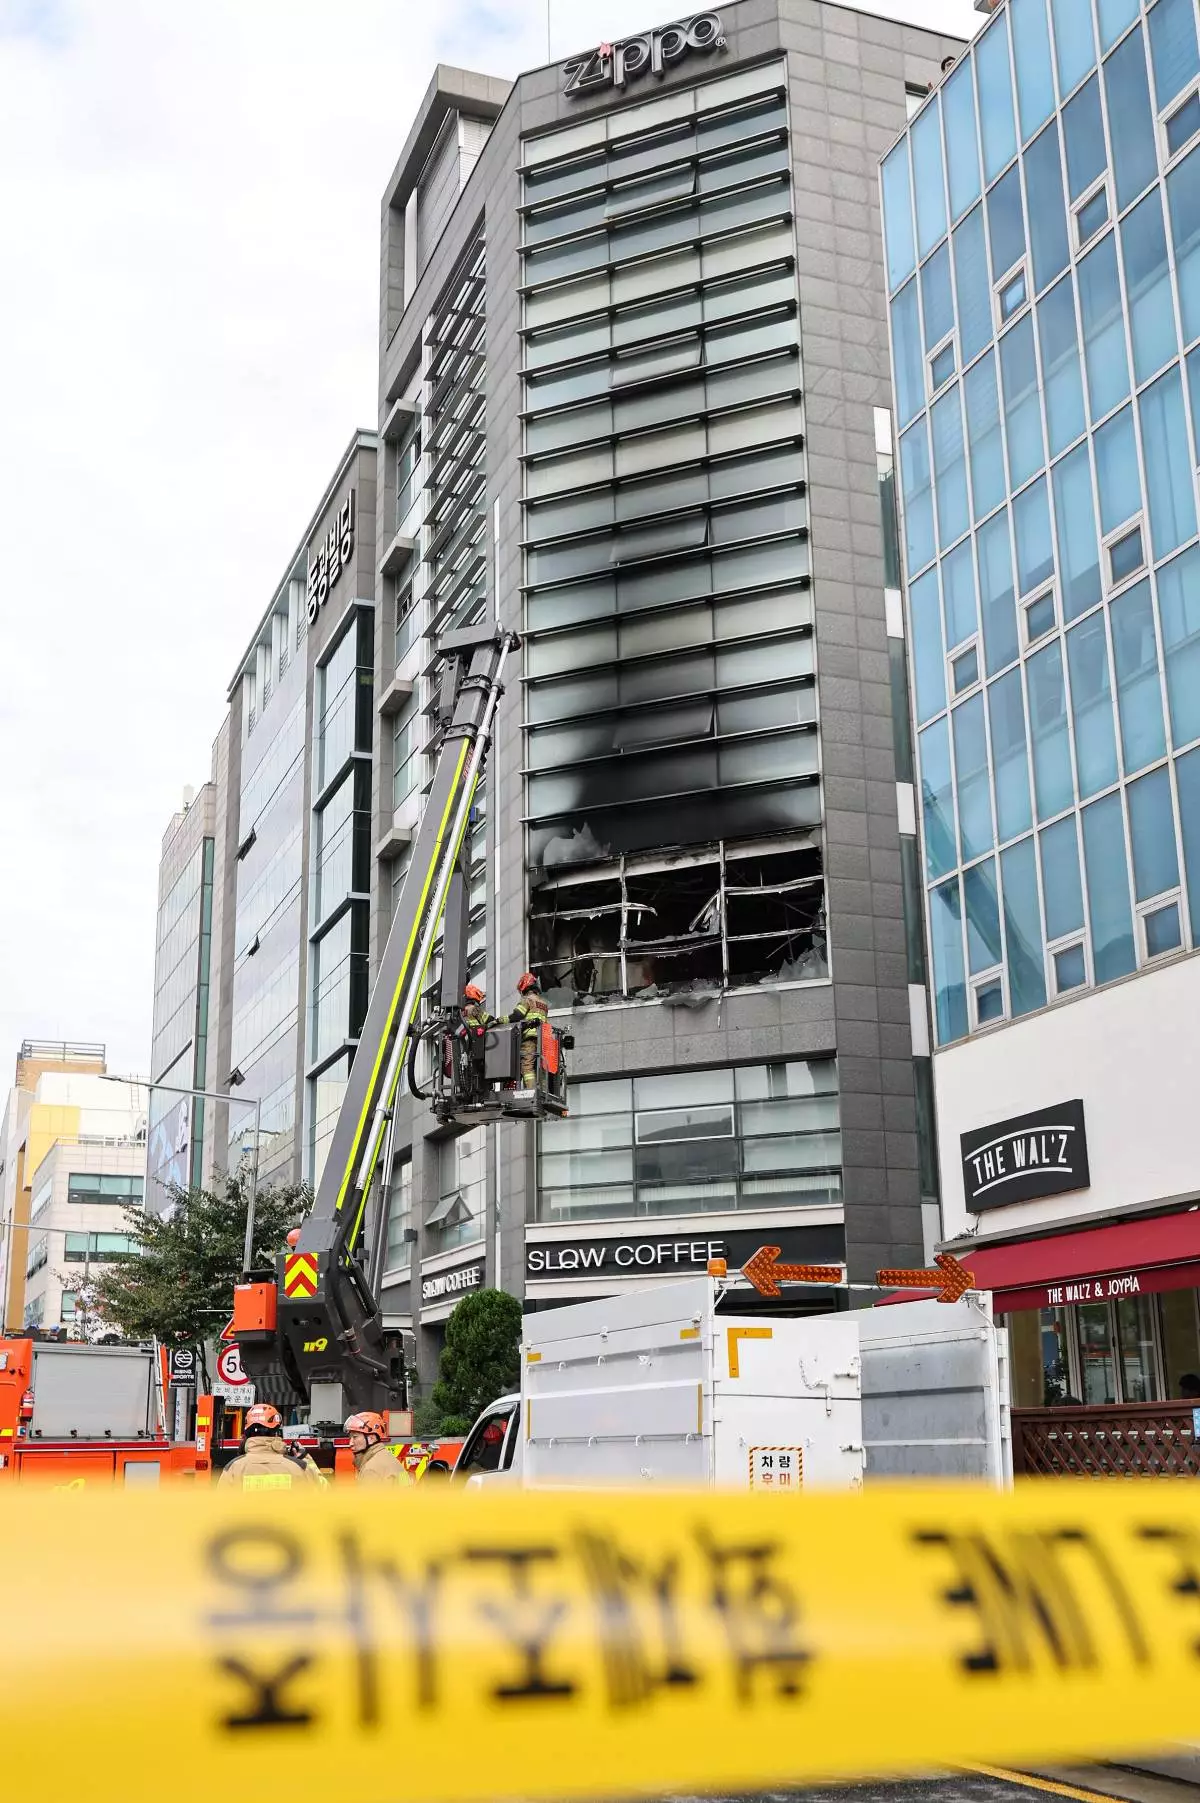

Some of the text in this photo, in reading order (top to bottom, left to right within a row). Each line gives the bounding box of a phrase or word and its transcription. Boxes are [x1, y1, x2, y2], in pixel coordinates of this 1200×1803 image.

[307, 488, 357, 626] 동광빌딩
[972, 1133, 1069, 1185] THE WAL'Z
[614, 1240, 725, 1266] COFFEE
[446, 1266, 480, 1293] COFFEE
[1047, 1286, 1063, 1304] THE
[1065, 1283, 1091, 1302] WAL'Z
[1094, 1282, 1104, 1297] &
[303, 1338, 328, 1353] 119
